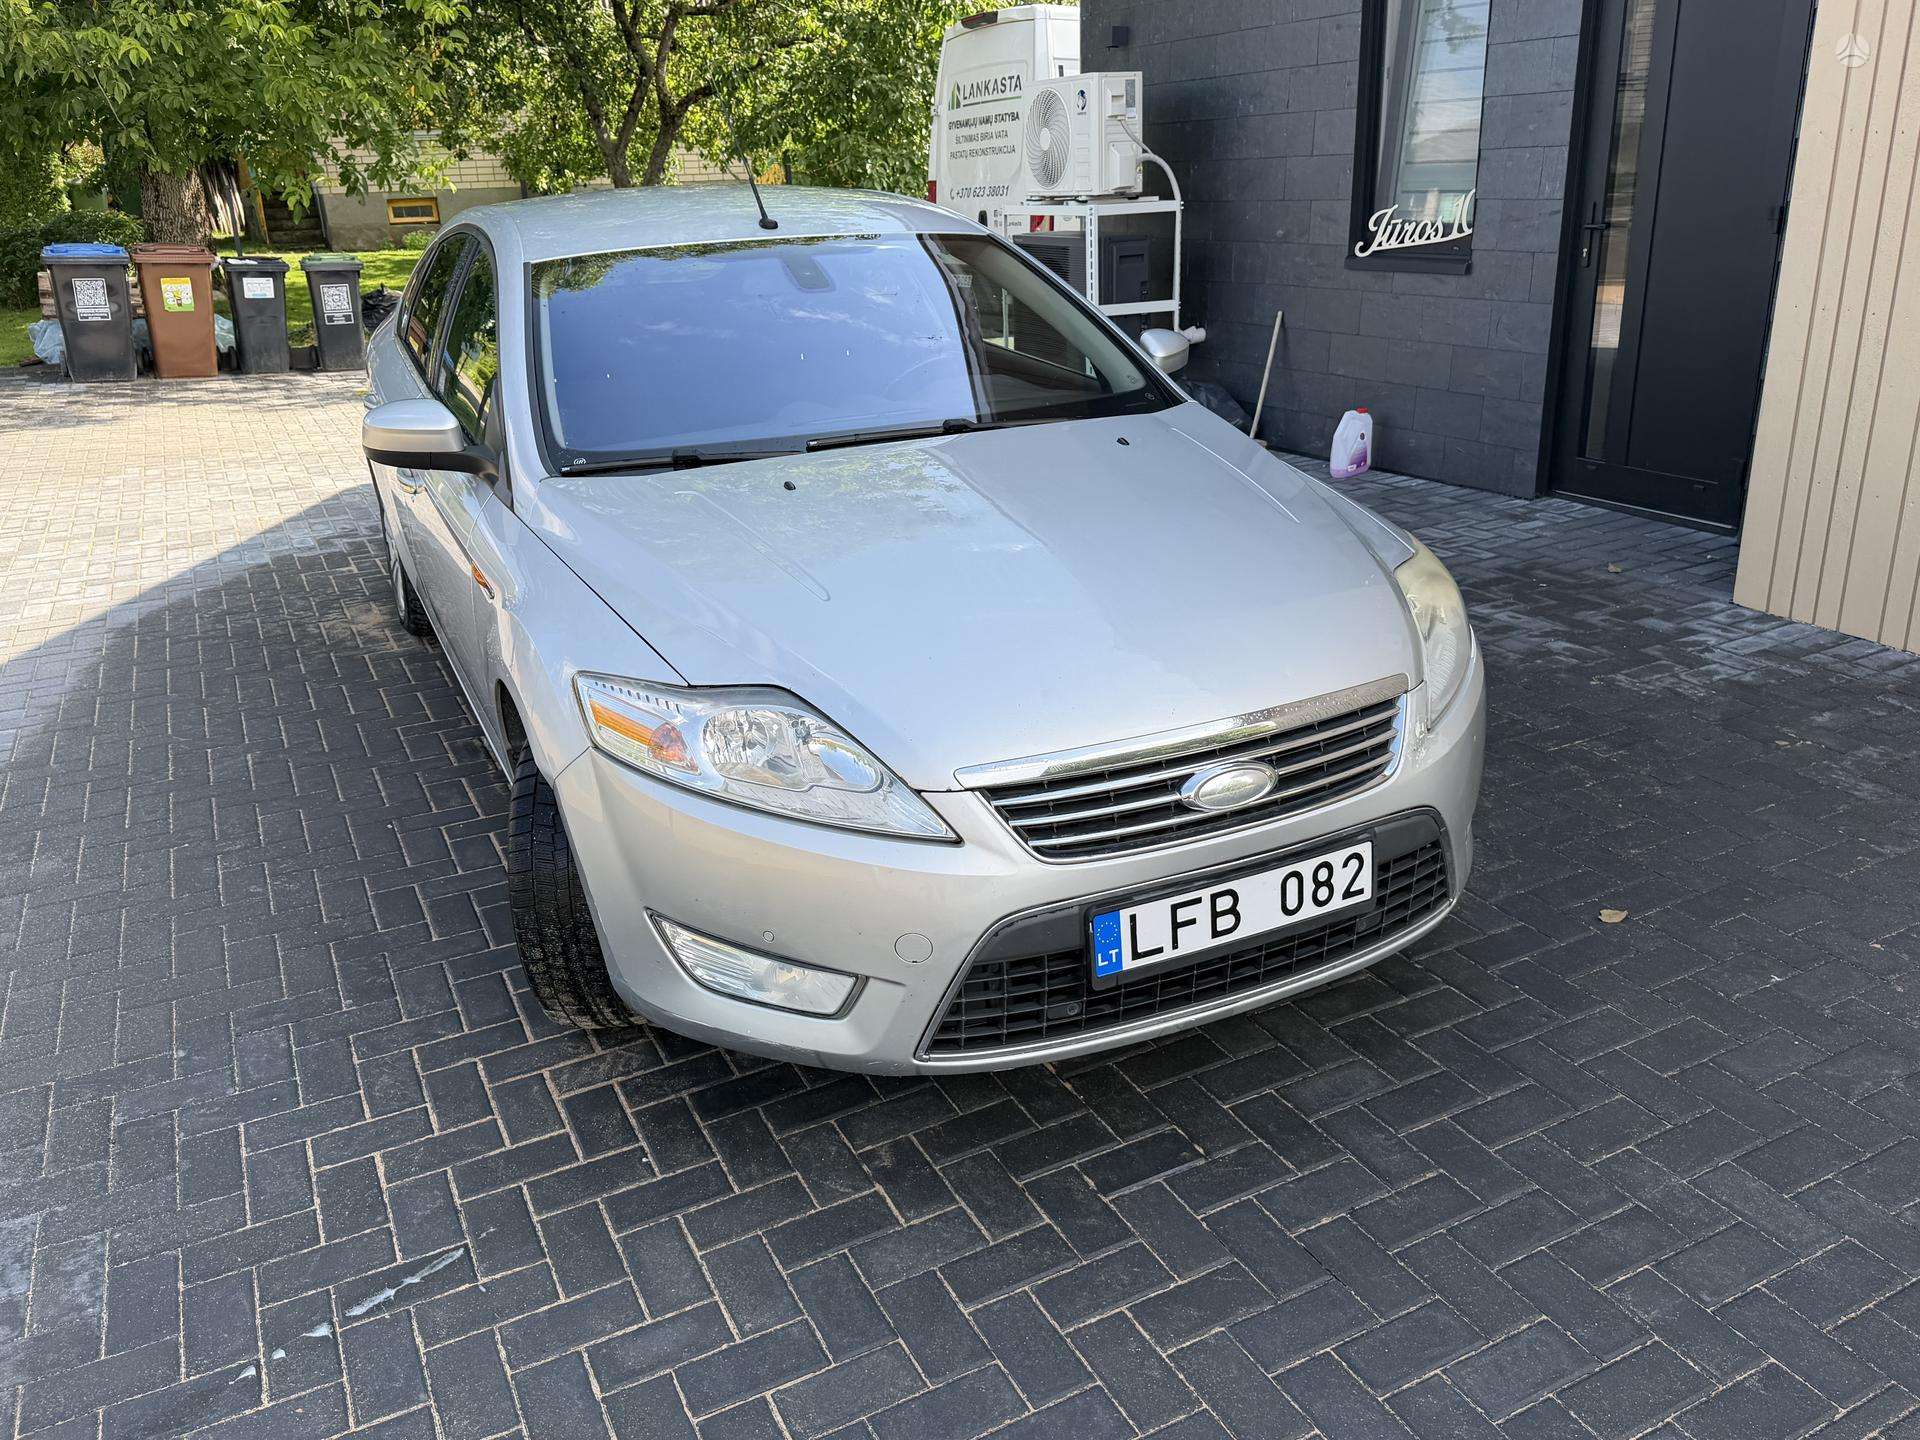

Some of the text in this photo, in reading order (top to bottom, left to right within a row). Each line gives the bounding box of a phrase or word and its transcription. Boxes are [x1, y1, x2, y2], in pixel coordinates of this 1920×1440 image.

[963, 74, 1022, 100] LANKASTA
[994, 111, 1020, 123] STATYBA
[994, 129, 1008, 139] VATA
[972, 186, 985, 197] 623
[987, 185, 1009, 196] 38031
[1128, 851, 1365, 962] LFB 082
[1097, 949, 1119, 966] LT
